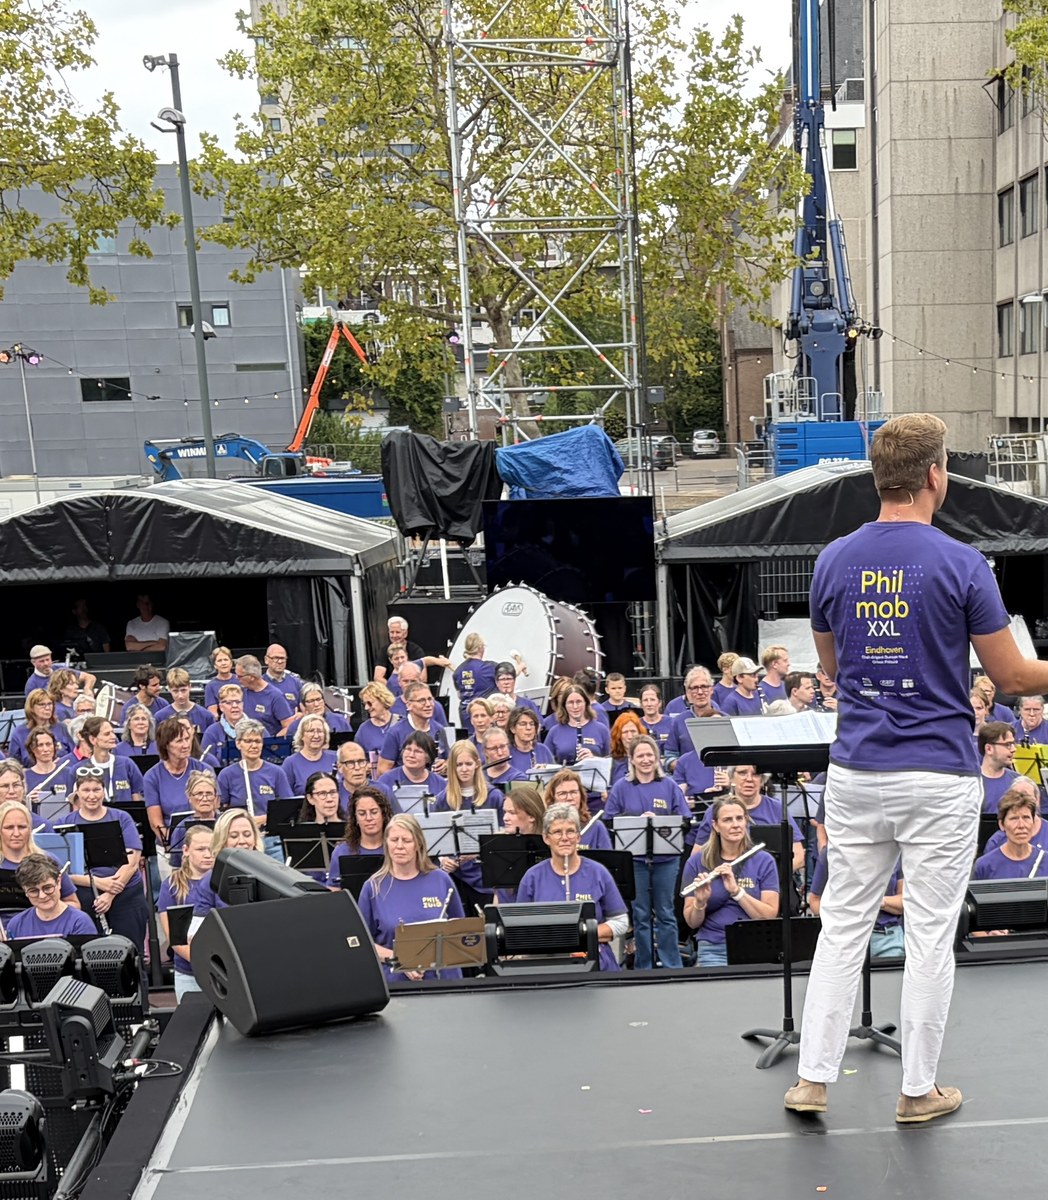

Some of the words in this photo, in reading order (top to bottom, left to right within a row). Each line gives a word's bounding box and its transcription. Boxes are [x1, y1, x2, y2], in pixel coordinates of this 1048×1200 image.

[861, 569, 904, 594] Phil
[856, 593, 910, 619] mob
[867, 620, 901, 637] XXL
[865, 645, 904, 654] Eindhoven
